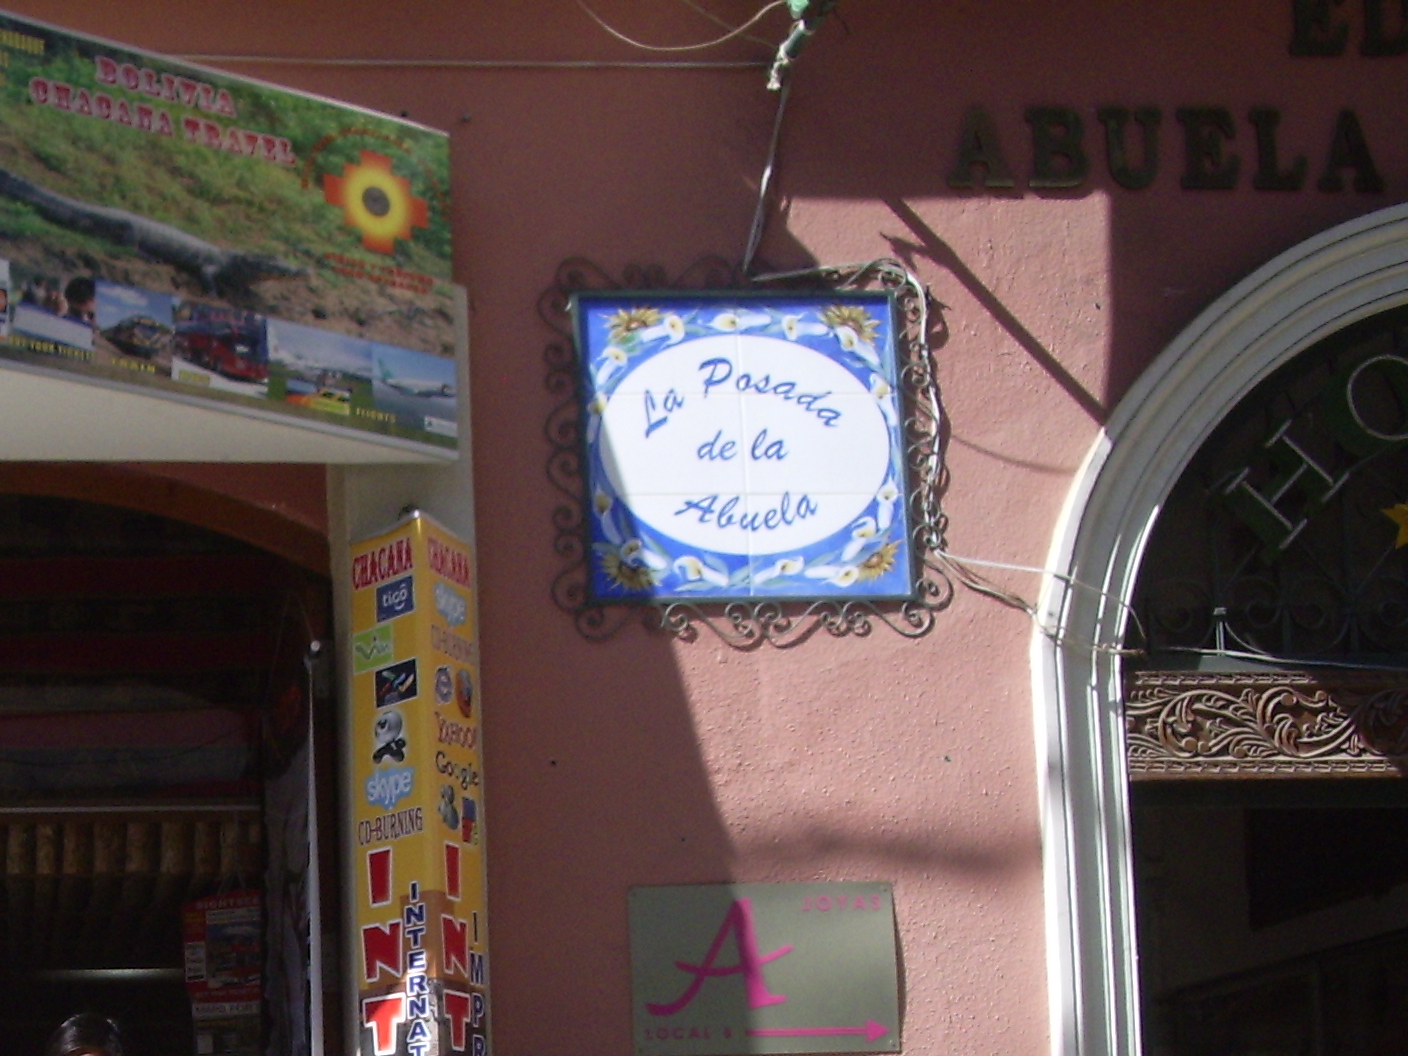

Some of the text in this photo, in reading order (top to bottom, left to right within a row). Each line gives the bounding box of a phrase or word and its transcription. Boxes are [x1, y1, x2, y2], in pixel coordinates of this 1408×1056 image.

[95, 55, 238, 118] BOLIVIA
[28, 77, 297, 167] CHACANA TRAVEL
[947, 107, 1386, 193] ABUELA
[645, 356, 844, 439] La Posada
[697, 428, 789, 461] de la
[674, 491, 819, 532] Abuela
[352, 536, 414, 591] CHACANA
[367, 769, 412, 809] skype
[435, 750, 479, 790] Google
[358, 806, 423, 845] CD-BURNING
[802, 894, 882, 912] JOYAS
